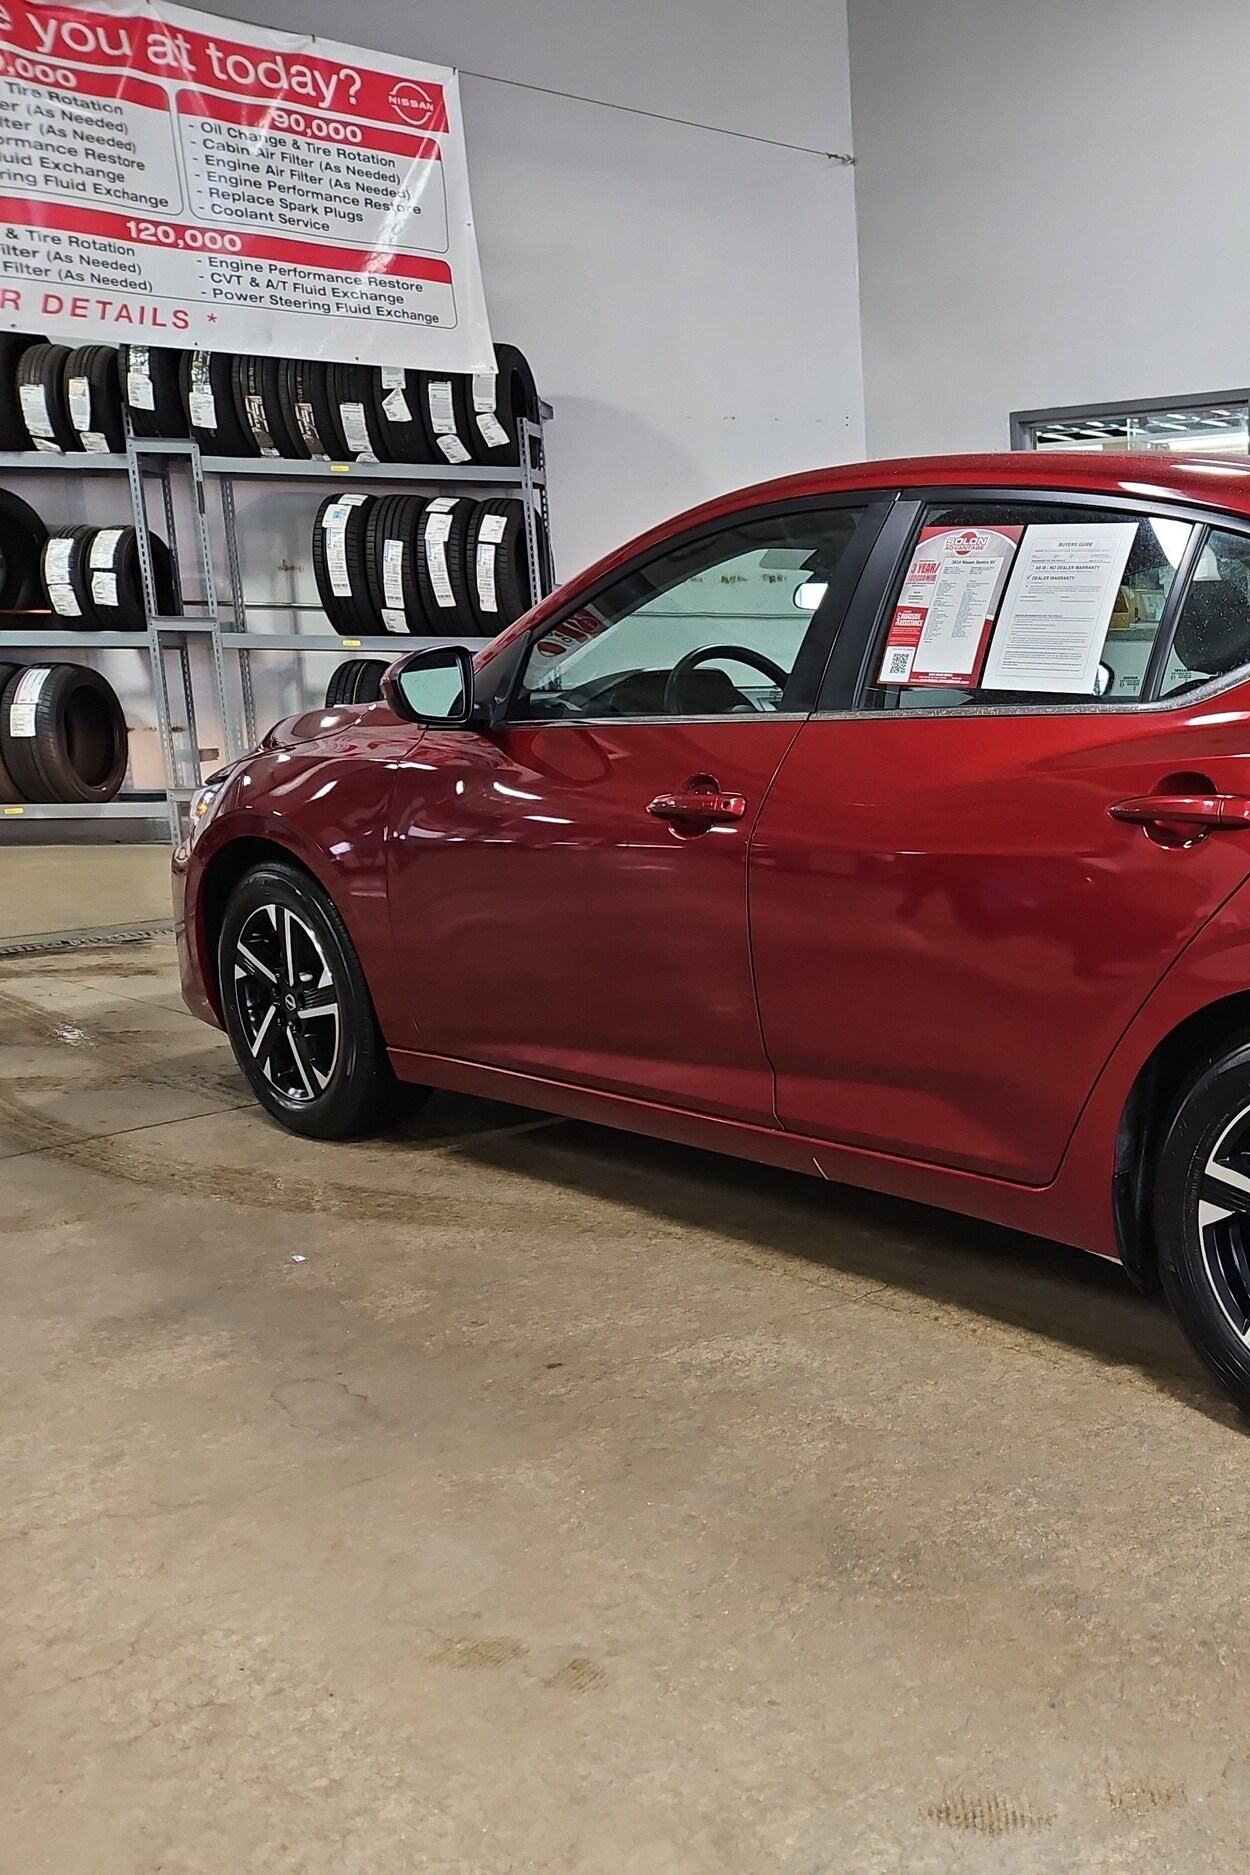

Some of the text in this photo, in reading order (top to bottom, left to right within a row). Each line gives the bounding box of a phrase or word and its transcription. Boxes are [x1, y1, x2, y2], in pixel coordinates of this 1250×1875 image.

[0, 55, 77, 88] ,000
[25, 13, 133, 57] you
[147, 33, 196, 72] at
[204, 42, 362, 109] today?
[3, 81, 123, 116] Tire Rotation
[388, 95, 434, 112] NISSAN
[27, 103, 55, 119] (As
[61, 110, 129, 136] Needed)
[271, 110, 362, 143] 90,000
[40, 122, 67, 138] (As
[73, 130, 136, 153] Needed)
[201, 121, 222, 136] Oil
[227, 126, 286, 148] Change
[292, 139, 301, 150] &
[304, 142, 331, 157] Tire
[337, 148, 395, 168] Rotation
[40, 156, 125, 183] Exchange
[85, 147, 146, 171] Restore
[203, 138, 250, 155] Cabin
[256, 148, 276, 160] Air
[281, 152, 314, 168] Filter
[319, 160, 342, 174] (As
[346, 165, 400, 186] Needed)
[44, 174, 86, 192] Fluid
[93, 182, 169, 208] Exchange
[205, 154, 260, 173] Engine
[265, 164, 285, 177] Air
[290, 169, 323, 186] Filter
[329, 177, 351, 191] (As
[356, 182, 410, 201] Needed)
[207, 171, 262, 190] Engine
[268, 182, 360, 207] Performance
[209, 187, 274, 208] Replace
[279, 198, 319, 216] Spark
[324, 207, 364, 223] Plugs
[211, 203, 274, 223] Coolant
[279, 210, 330, 232] Service
[6, 227, 135, 257] & Tire Rotation
[126, 220, 242, 252] 120,000
[3, 260, 153, 294] Filter (As Needed)
[47, 249, 73, 264] (As
[79, 254, 142, 276] Needed)
[208, 256, 264, 275] Engine
[269, 264, 362, 286] Performance
[368, 277, 423, 293] Restore
[210, 272, 243, 286] CVT
[250, 277, 261, 288] &
[265, 278, 290, 291] A/T
[293, 282, 326, 297] Fluid
[331, 288, 404, 305] Exchange
[41, 293, 190, 329] DETAILS
[212, 288, 264, 304] Power
[269, 294, 331, 314] Steering
[336, 302, 371, 316] Fluid
[376, 306, 440, 326] Exchange
[946, 536, 989, 546] SOLON
[911, 562, 918, 574] 3
